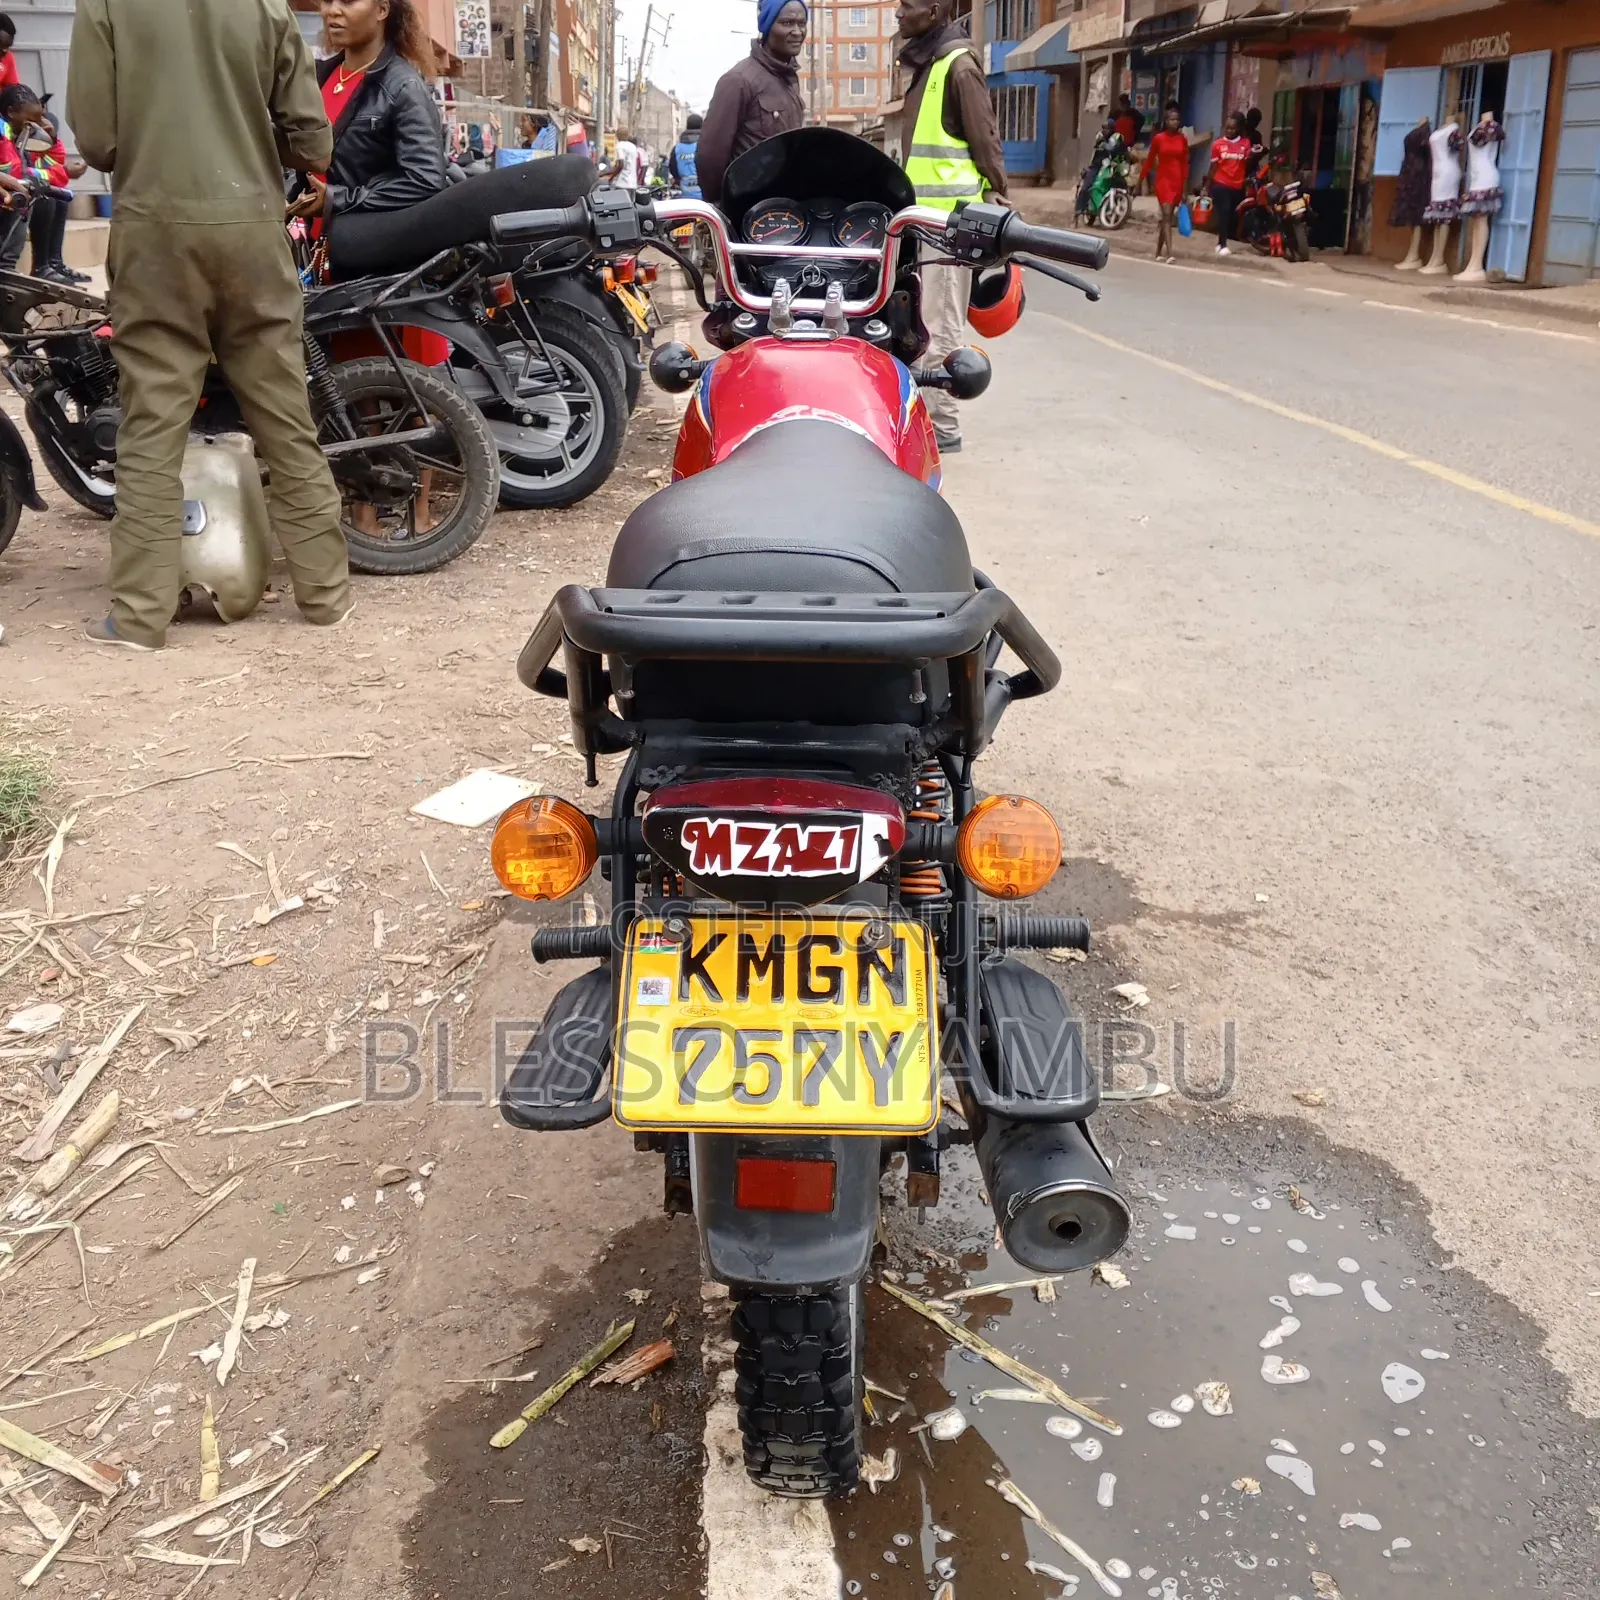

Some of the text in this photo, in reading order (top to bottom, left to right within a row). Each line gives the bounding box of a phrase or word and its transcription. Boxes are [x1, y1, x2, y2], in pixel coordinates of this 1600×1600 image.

[681, 817, 860, 876] MZAZI
[678, 934, 908, 1008] KMGN
[672, 1028, 905, 1107] 757Y
